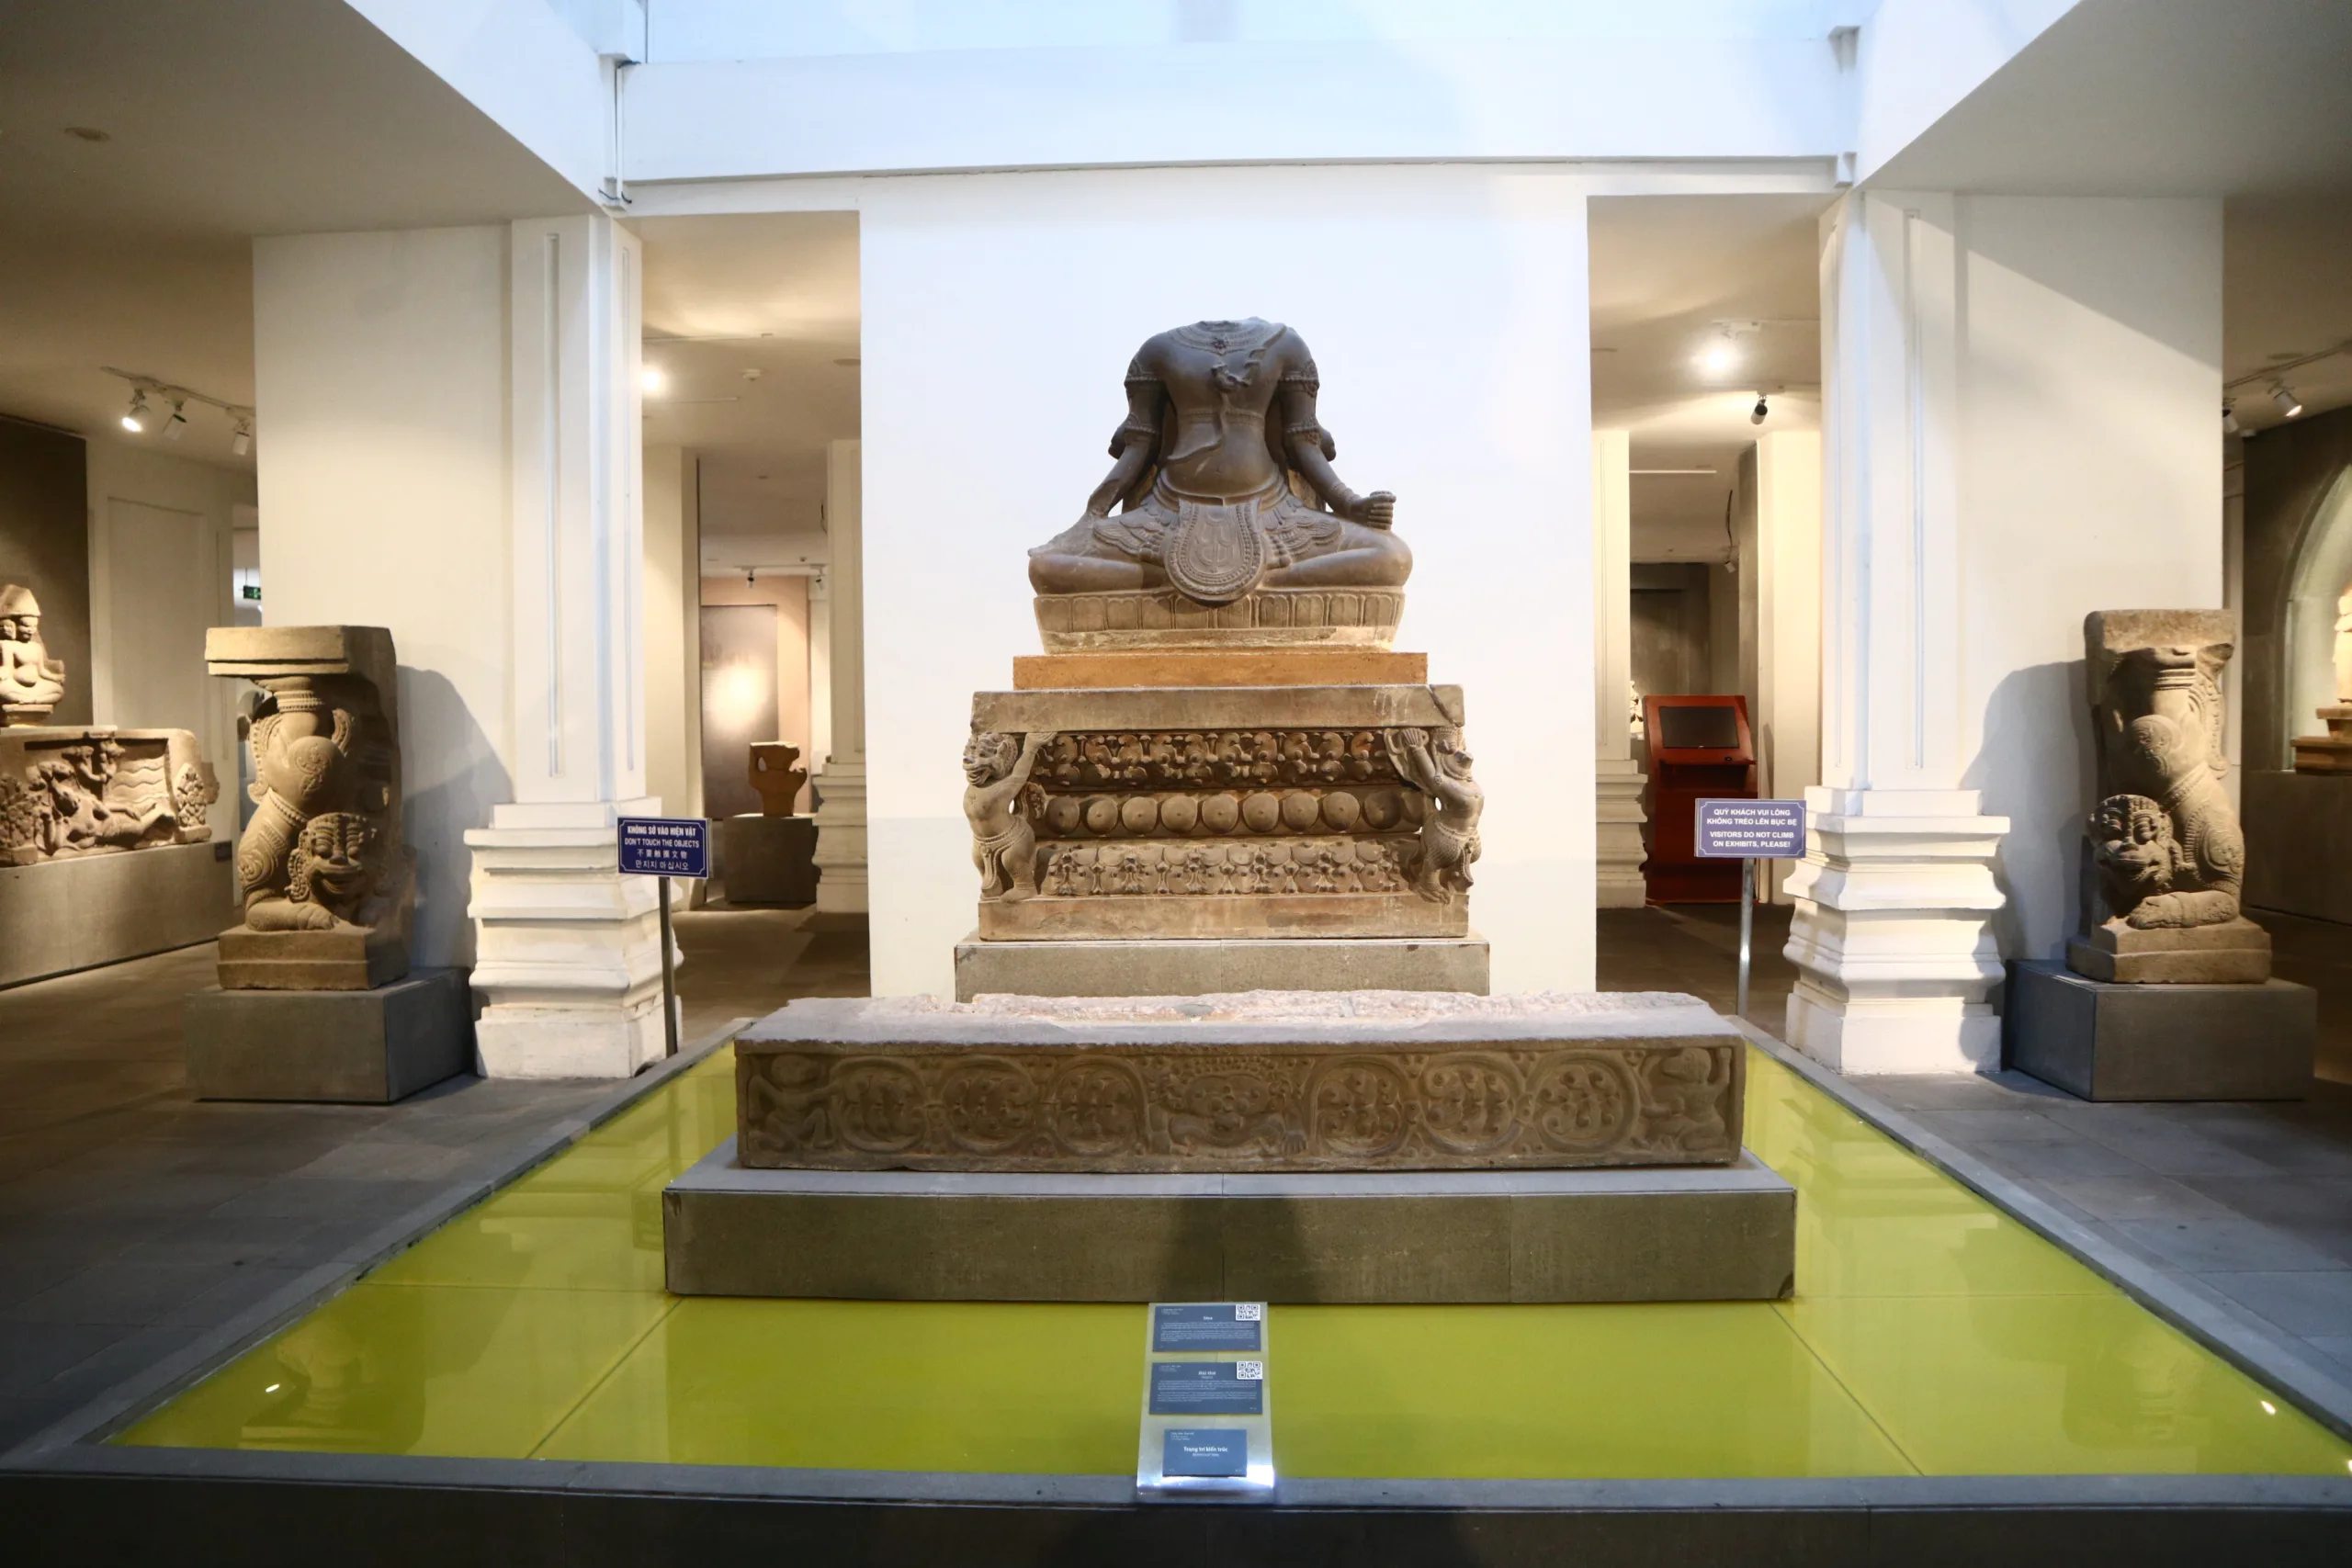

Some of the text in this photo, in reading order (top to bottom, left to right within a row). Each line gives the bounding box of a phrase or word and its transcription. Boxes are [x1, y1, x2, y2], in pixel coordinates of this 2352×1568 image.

[1713, 807, 1729, 816] QUÝ
[1730, 807, 1756, 816] KHÁCH
[1770, 807, 1791, 817] LÒNG
[1706, 817, 1733, 825] KHÔNG
[1734, 817, 1754, 825] TRÈO
[1755, 817, 1770, 825] LÊN
[1770, 818, 1786, 827] BỤC
[627, 825, 647, 835] KHÔNG
[657, 826, 669, 836] VÀO
[670, 826, 684, 837] HIỆN
[684, 827, 696, 838] VẬT
[624, 837, 700, 848] DON'T TOUCH THE OBJECTS
[1724, 840, 1759, 849] EXHIBITS,
